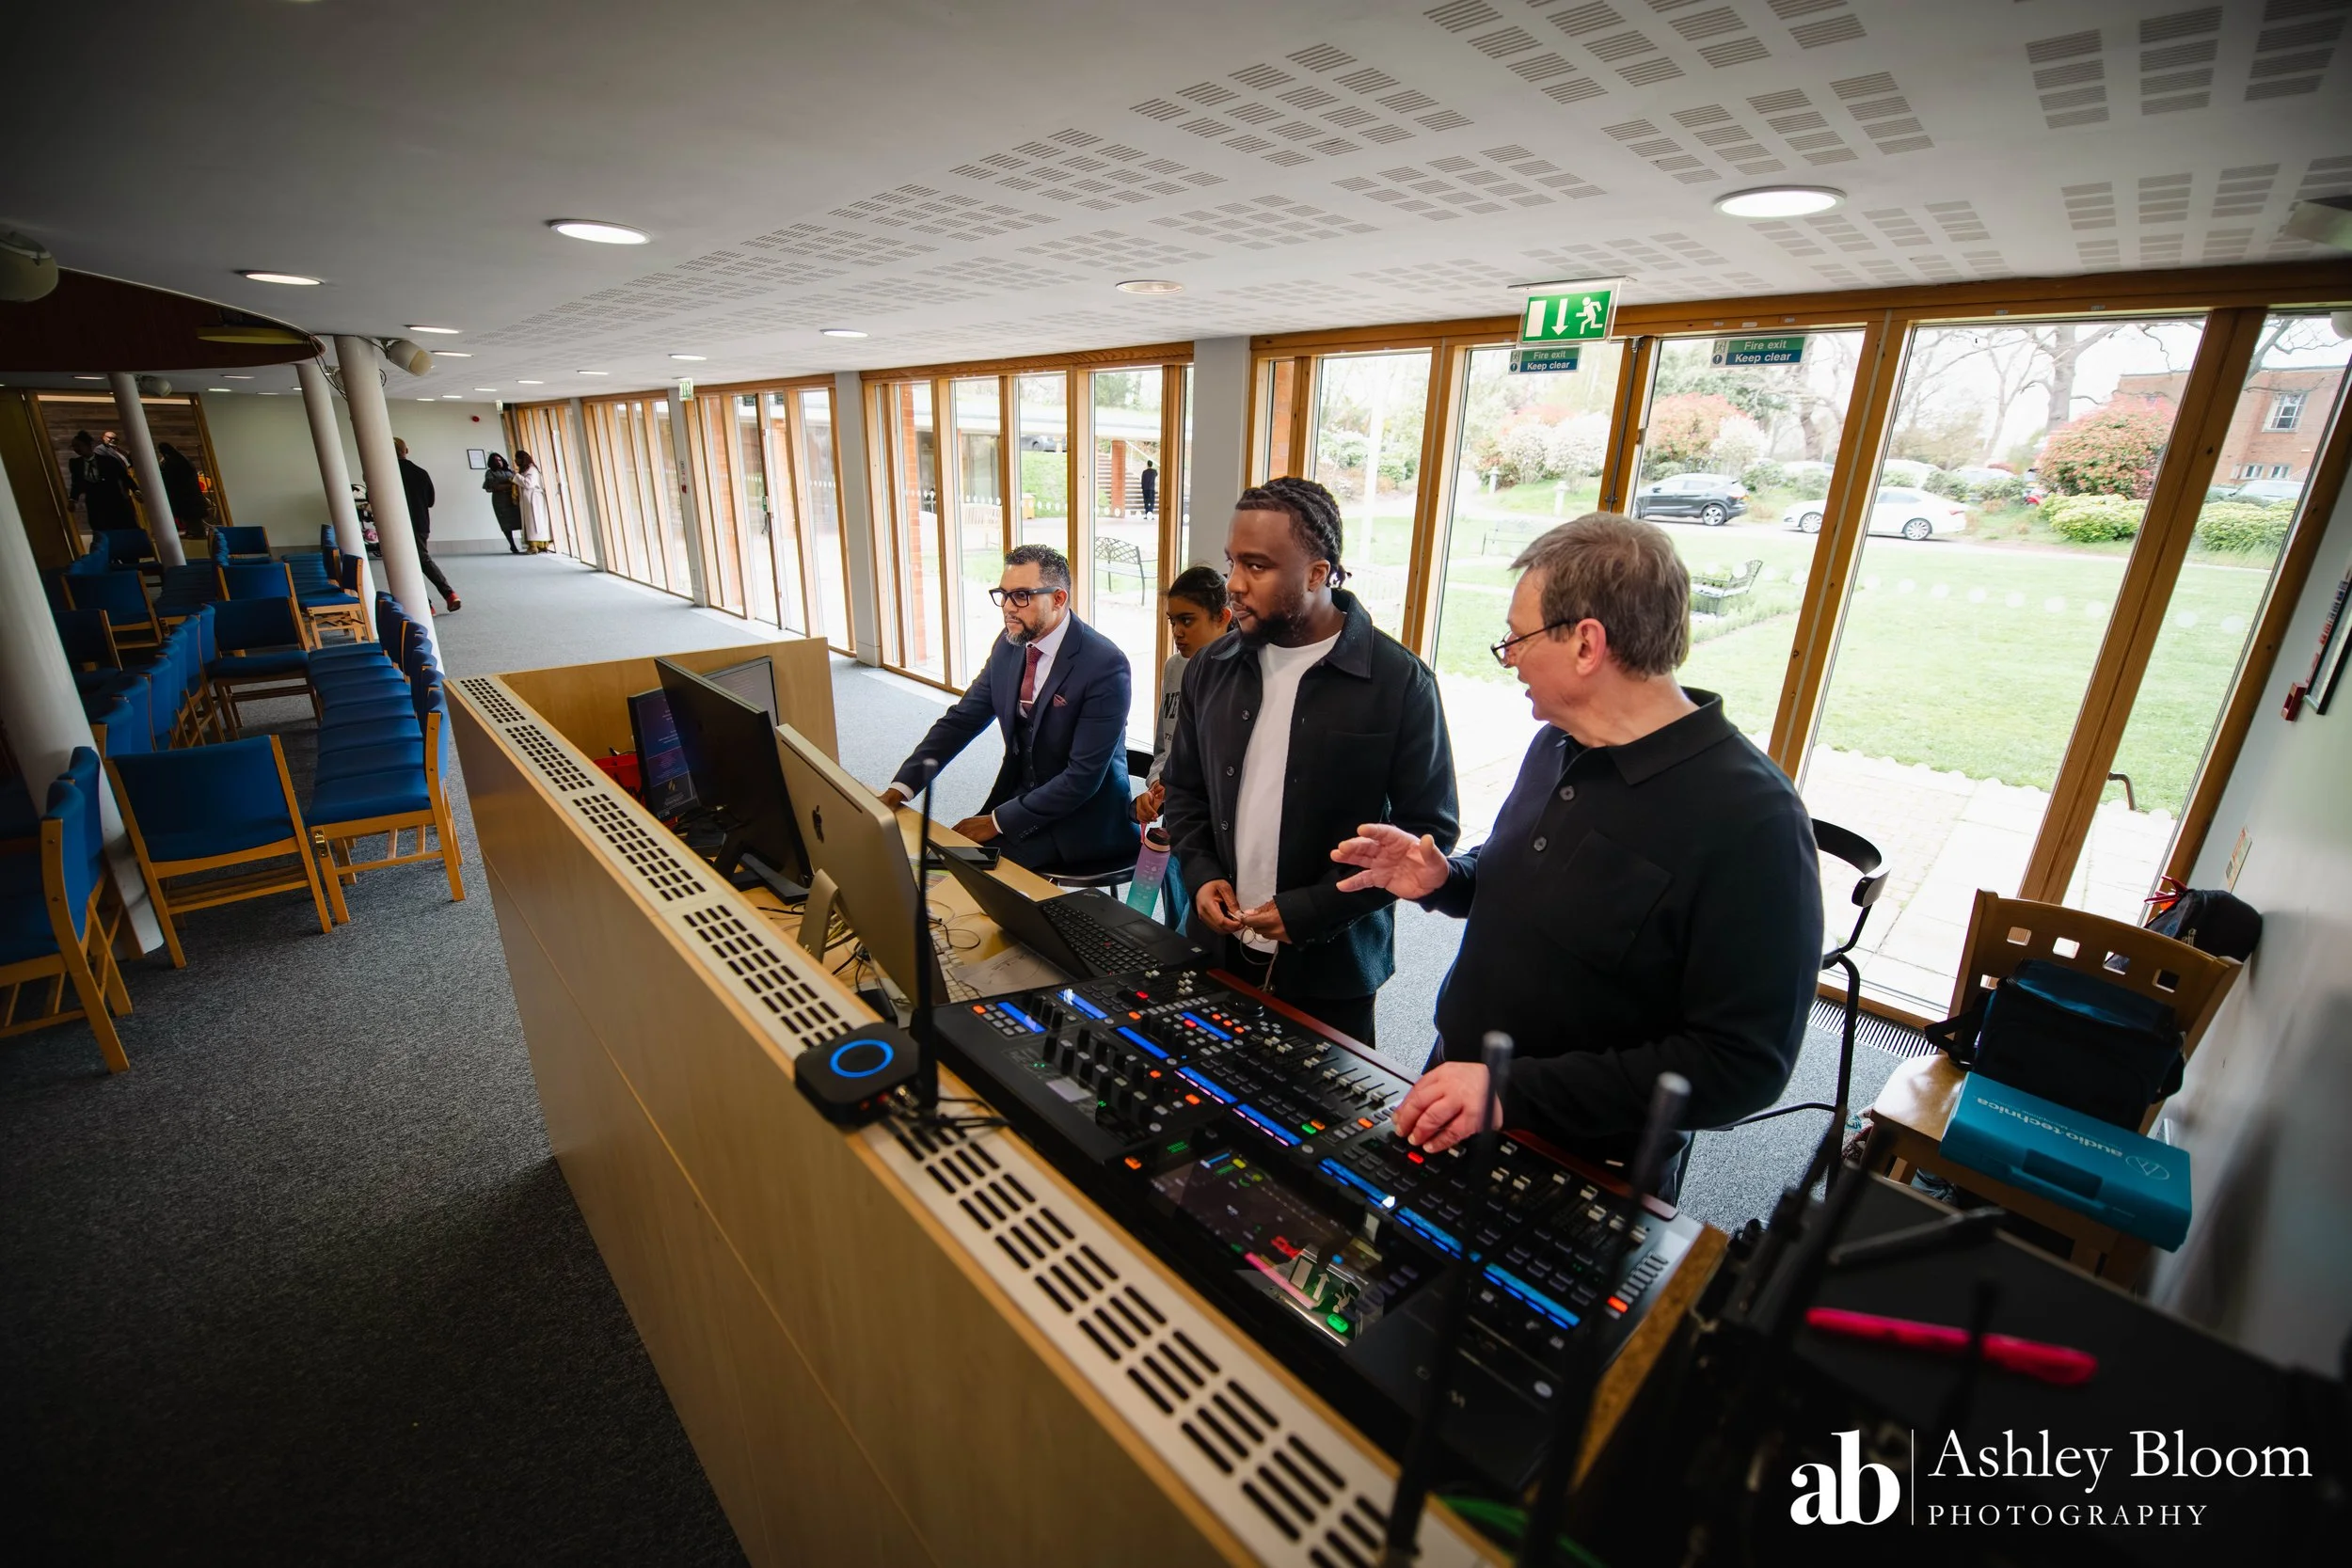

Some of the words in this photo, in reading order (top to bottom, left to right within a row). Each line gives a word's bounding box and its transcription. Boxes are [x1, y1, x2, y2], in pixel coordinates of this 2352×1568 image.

[1744, 341, 1764, 350] Fire
[1767, 340, 1787, 349] exit
[1534, 351, 1549, 359] Fire
[1550, 350, 1566, 358] exit
[1735, 354, 1761, 364] Keep
[1764, 352, 1791, 361] clear
[1527, 362, 1548, 372] Keep
[1549, 360, 1570, 370] clear
